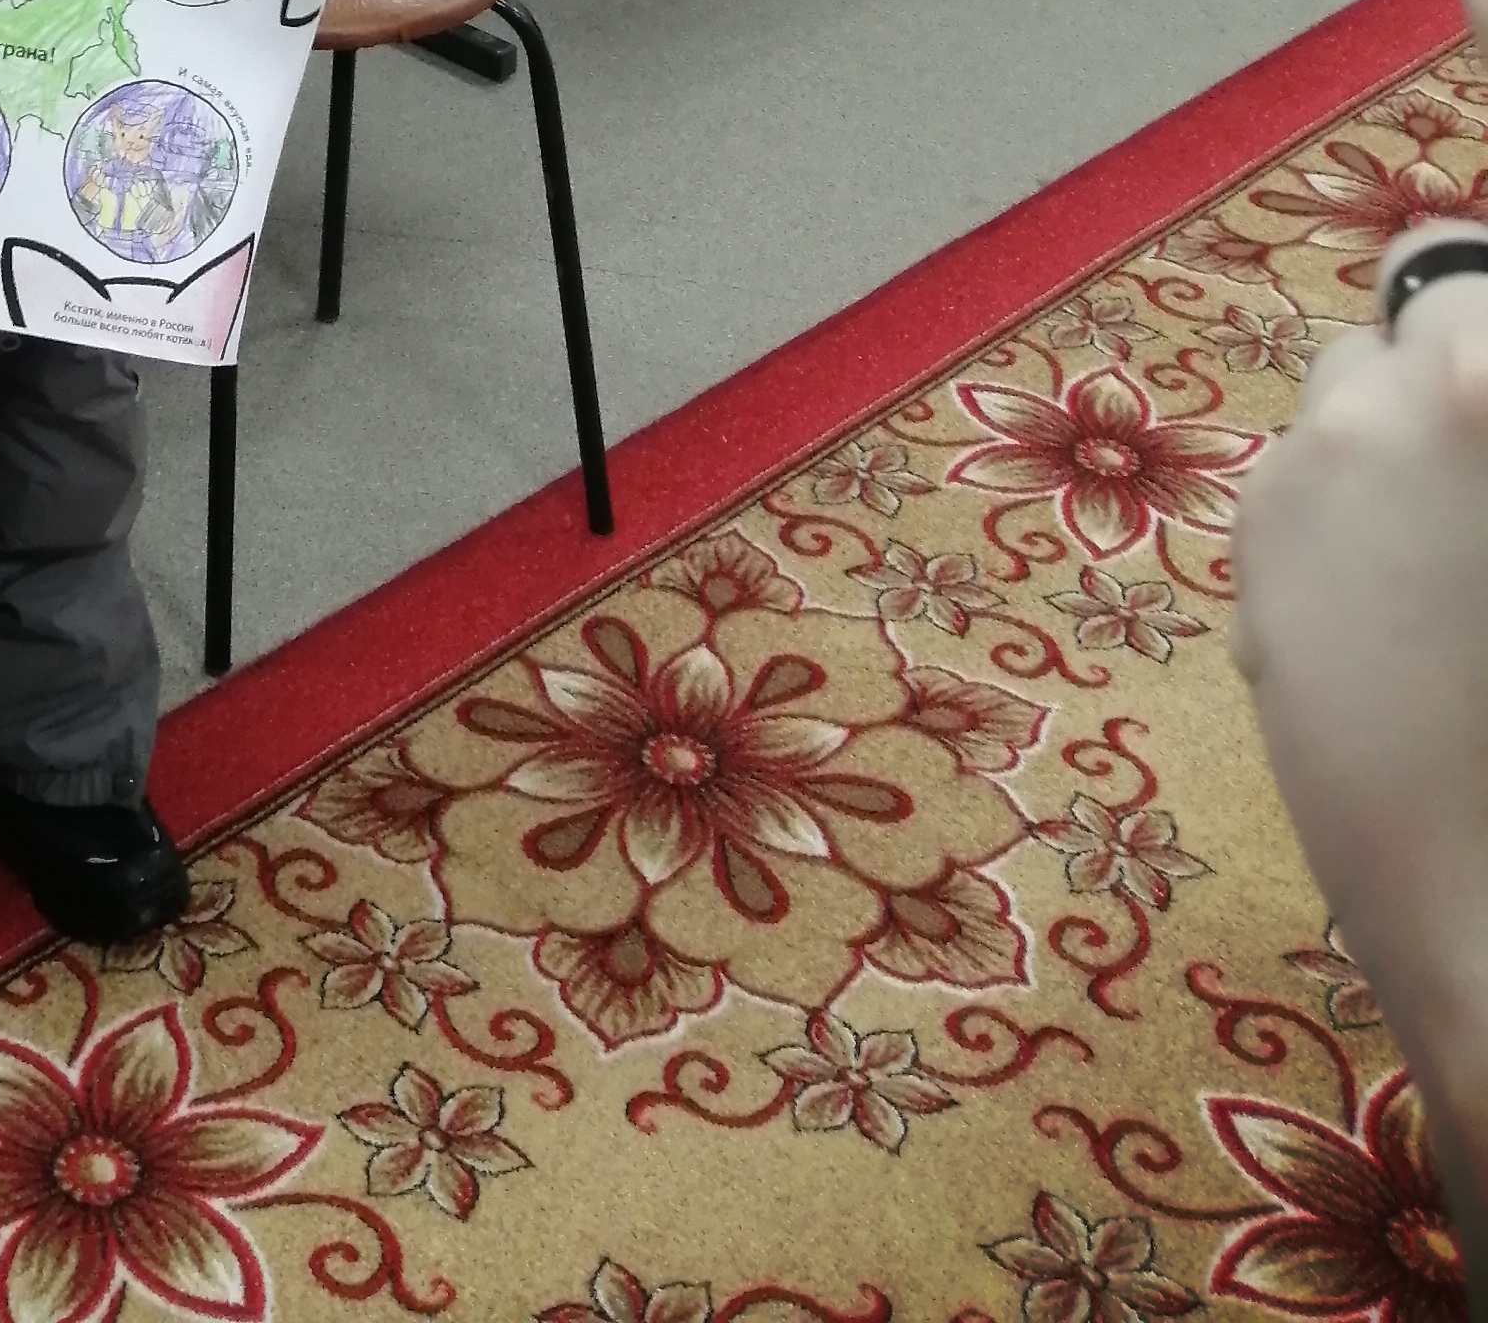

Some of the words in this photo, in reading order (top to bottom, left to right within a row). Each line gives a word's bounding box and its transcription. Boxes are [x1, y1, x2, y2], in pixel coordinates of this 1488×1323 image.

[192, 75, 223, 98] самая
[224, 100, 250, 142] вкусная
[53, 311, 97, 330] больше
[99, 322, 129, 335] всего
[130, 328, 165, 342] любят
[63, 300, 103, 319] Кстати,
[106, 311, 149, 326] именно
[150, 319, 157, 327] в
[159, 318, 194, 333] России
